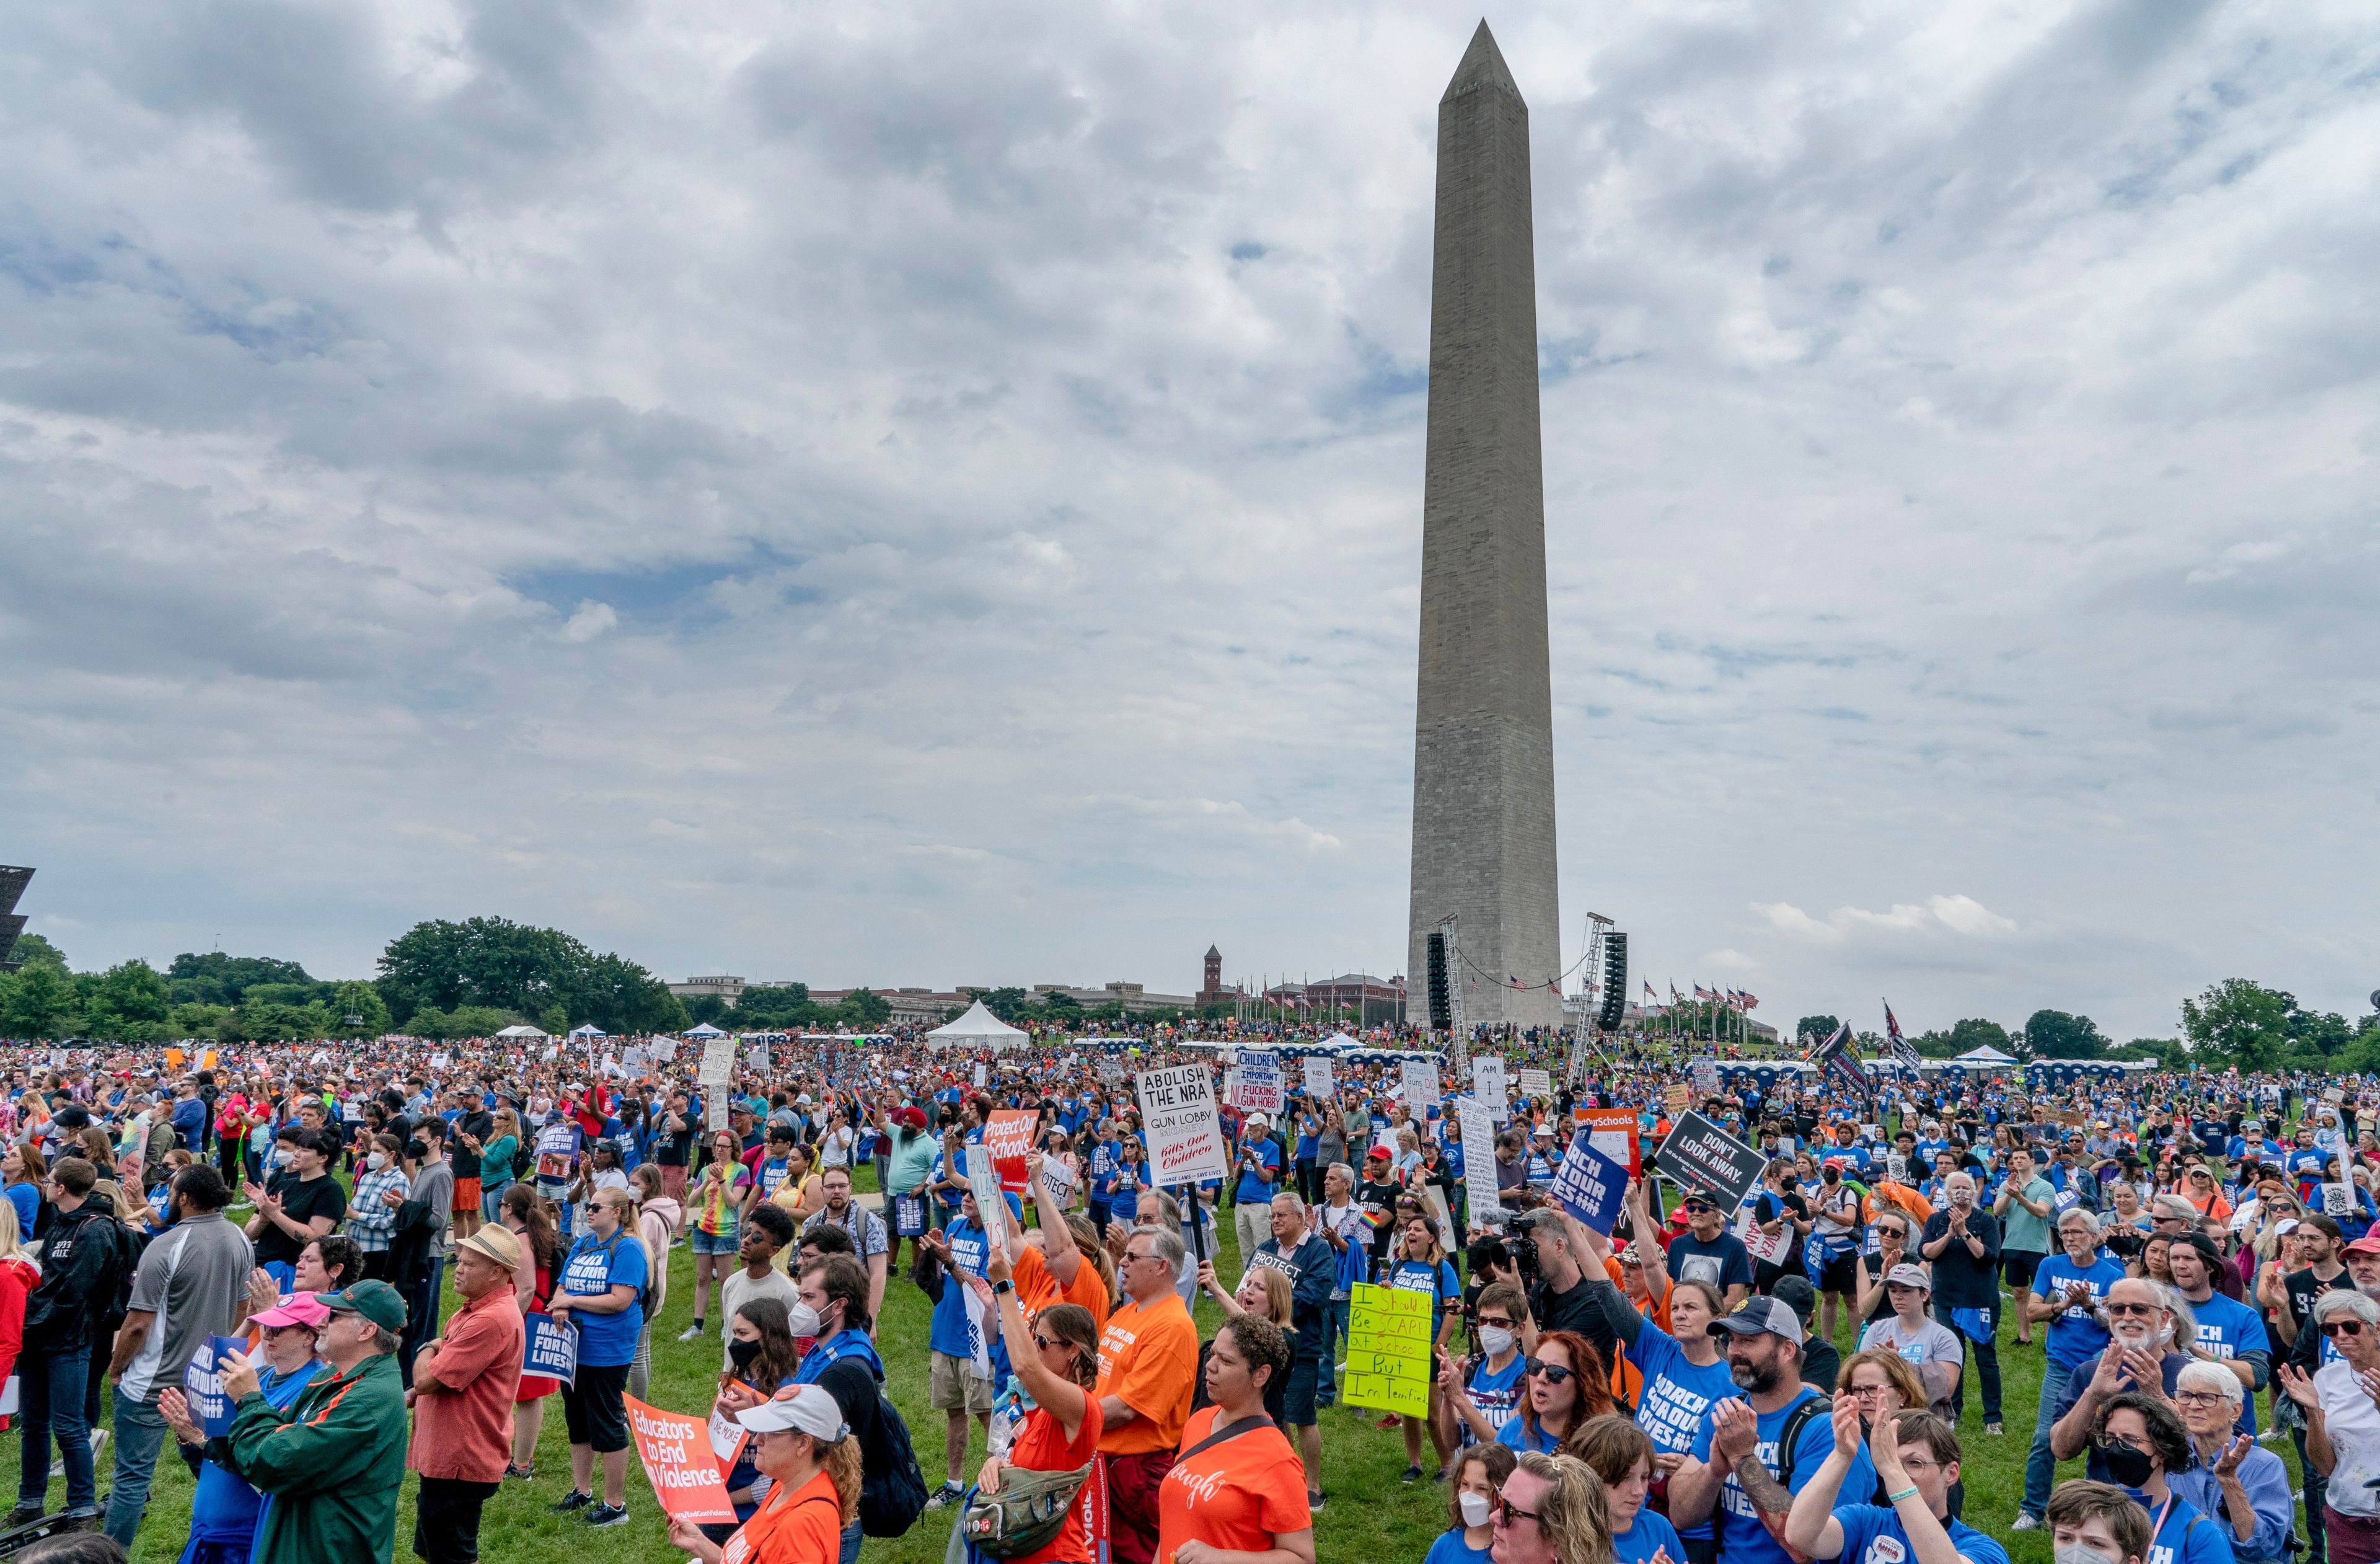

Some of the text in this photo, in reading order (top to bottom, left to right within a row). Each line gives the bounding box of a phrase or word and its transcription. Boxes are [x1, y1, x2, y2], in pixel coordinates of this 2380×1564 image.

[710, 1054, 729, 1070] KIDS
[1240, 1052, 1278, 1067] CHILDREN
[1145, 1067, 1205, 1090] ABOLISH
[1241, 1071, 1279, 1081] IMPORTANT
[1407, 1076, 1435, 1090] Guns DO
[1145, 1088, 1175, 1107] THE
[1180, 1083, 1208, 1102] NRA
[1243, 1085, 1277, 1096] FUCKING
[1406, 1088, 1437, 1103] Kill People
[1488, 1081, 1491, 1095] I
[1241, 1095, 1256, 1107] GUN
[1258, 1097, 1280, 1108] HOBBY
[984, 1115, 1037, 1138] Protect Our
[1151, 1110, 1211, 1129] GUN LOBBY
[542, 1134, 573, 1144] FOR OUR
[1160, 1123, 1205, 1137] MONEY
[539, 1142, 560, 1151] LIVES
[989, 1133, 1029, 1160] Schools
[1161, 1133, 1209, 1159] Kills Our
[1702, 1131, 1739, 1162] DON'T
[1162, 1145, 1212, 1170] Children
[1679, 1135, 1711, 1161] LOOK
[1708, 1157, 1742, 1184] AWAY.
[2297, 1155, 2316, 1164] MARCH
[765, 1167, 788, 1177] MARCH
[1678, 1155, 1691, 1167] Senate
[1709, 1177, 1722, 1188] safety
[1681, 1165, 1690, 1173] Text
[1160, 1175, 1178, 1183] CHANGE
[1568, 1169, 1606, 1201] OUR
[581, 1266, 608, 1279] OUR
[1254, 1252, 1302, 1279] PROTECT
[1354, 1284, 1374, 1304] I
[1352, 1309, 1432, 1337] Be SCARED
[534, 1335, 562, 1353] FOR
[1351, 1336, 1370, 1348] at
[531, 1350, 567, 1369] LIVES
[1373, 1354, 1403, 1374] But
[199, 1370, 224, 1395] OUR
[1655, 1372, 1710, 1414] MARCH
[632, 1408, 695, 1440] Educators
[1638, 1403, 1675, 1447] LIVES
[721, 1426, 741, 1444] MORE
[645, 1438, 687, 1464] to End
